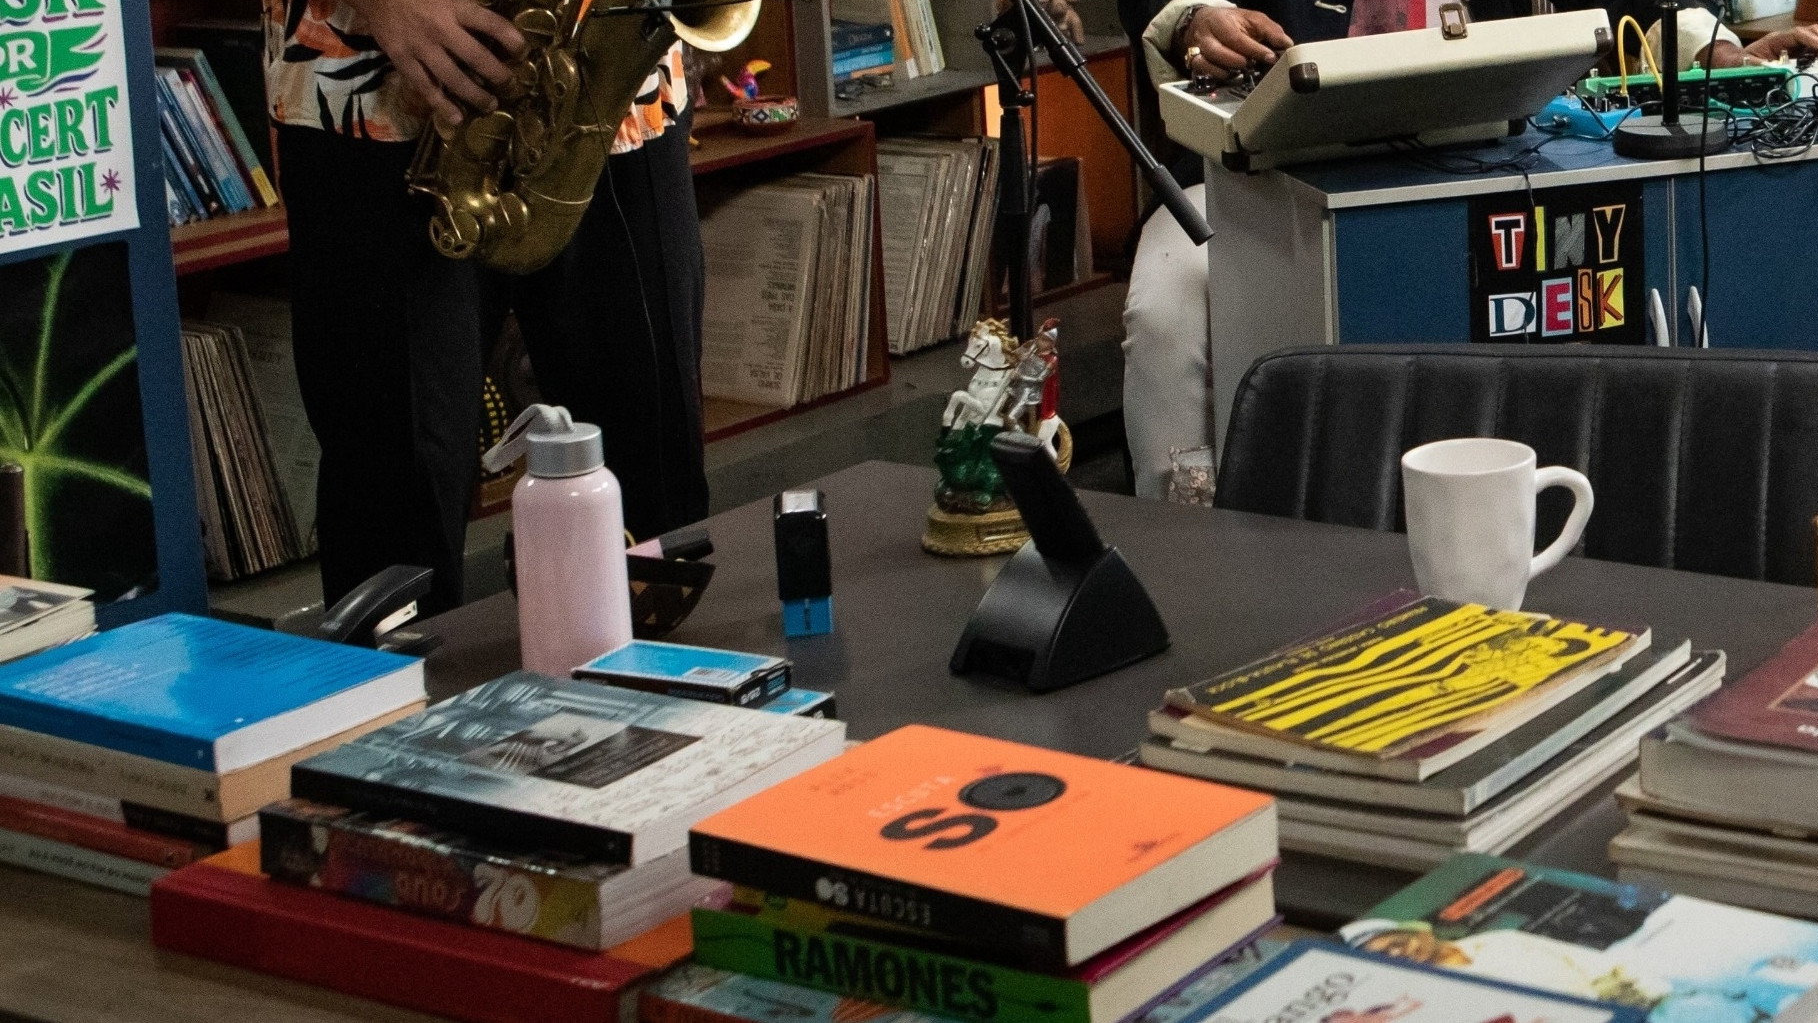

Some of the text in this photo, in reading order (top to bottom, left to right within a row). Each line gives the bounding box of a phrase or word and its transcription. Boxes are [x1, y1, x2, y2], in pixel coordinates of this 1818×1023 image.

[1487, 204, 1627, 271] TINY
[1488, 267, 1626, 338] DESK
[472, 863, 540, 933] 70
[771, 929, 1000, 1019] RAMONES
